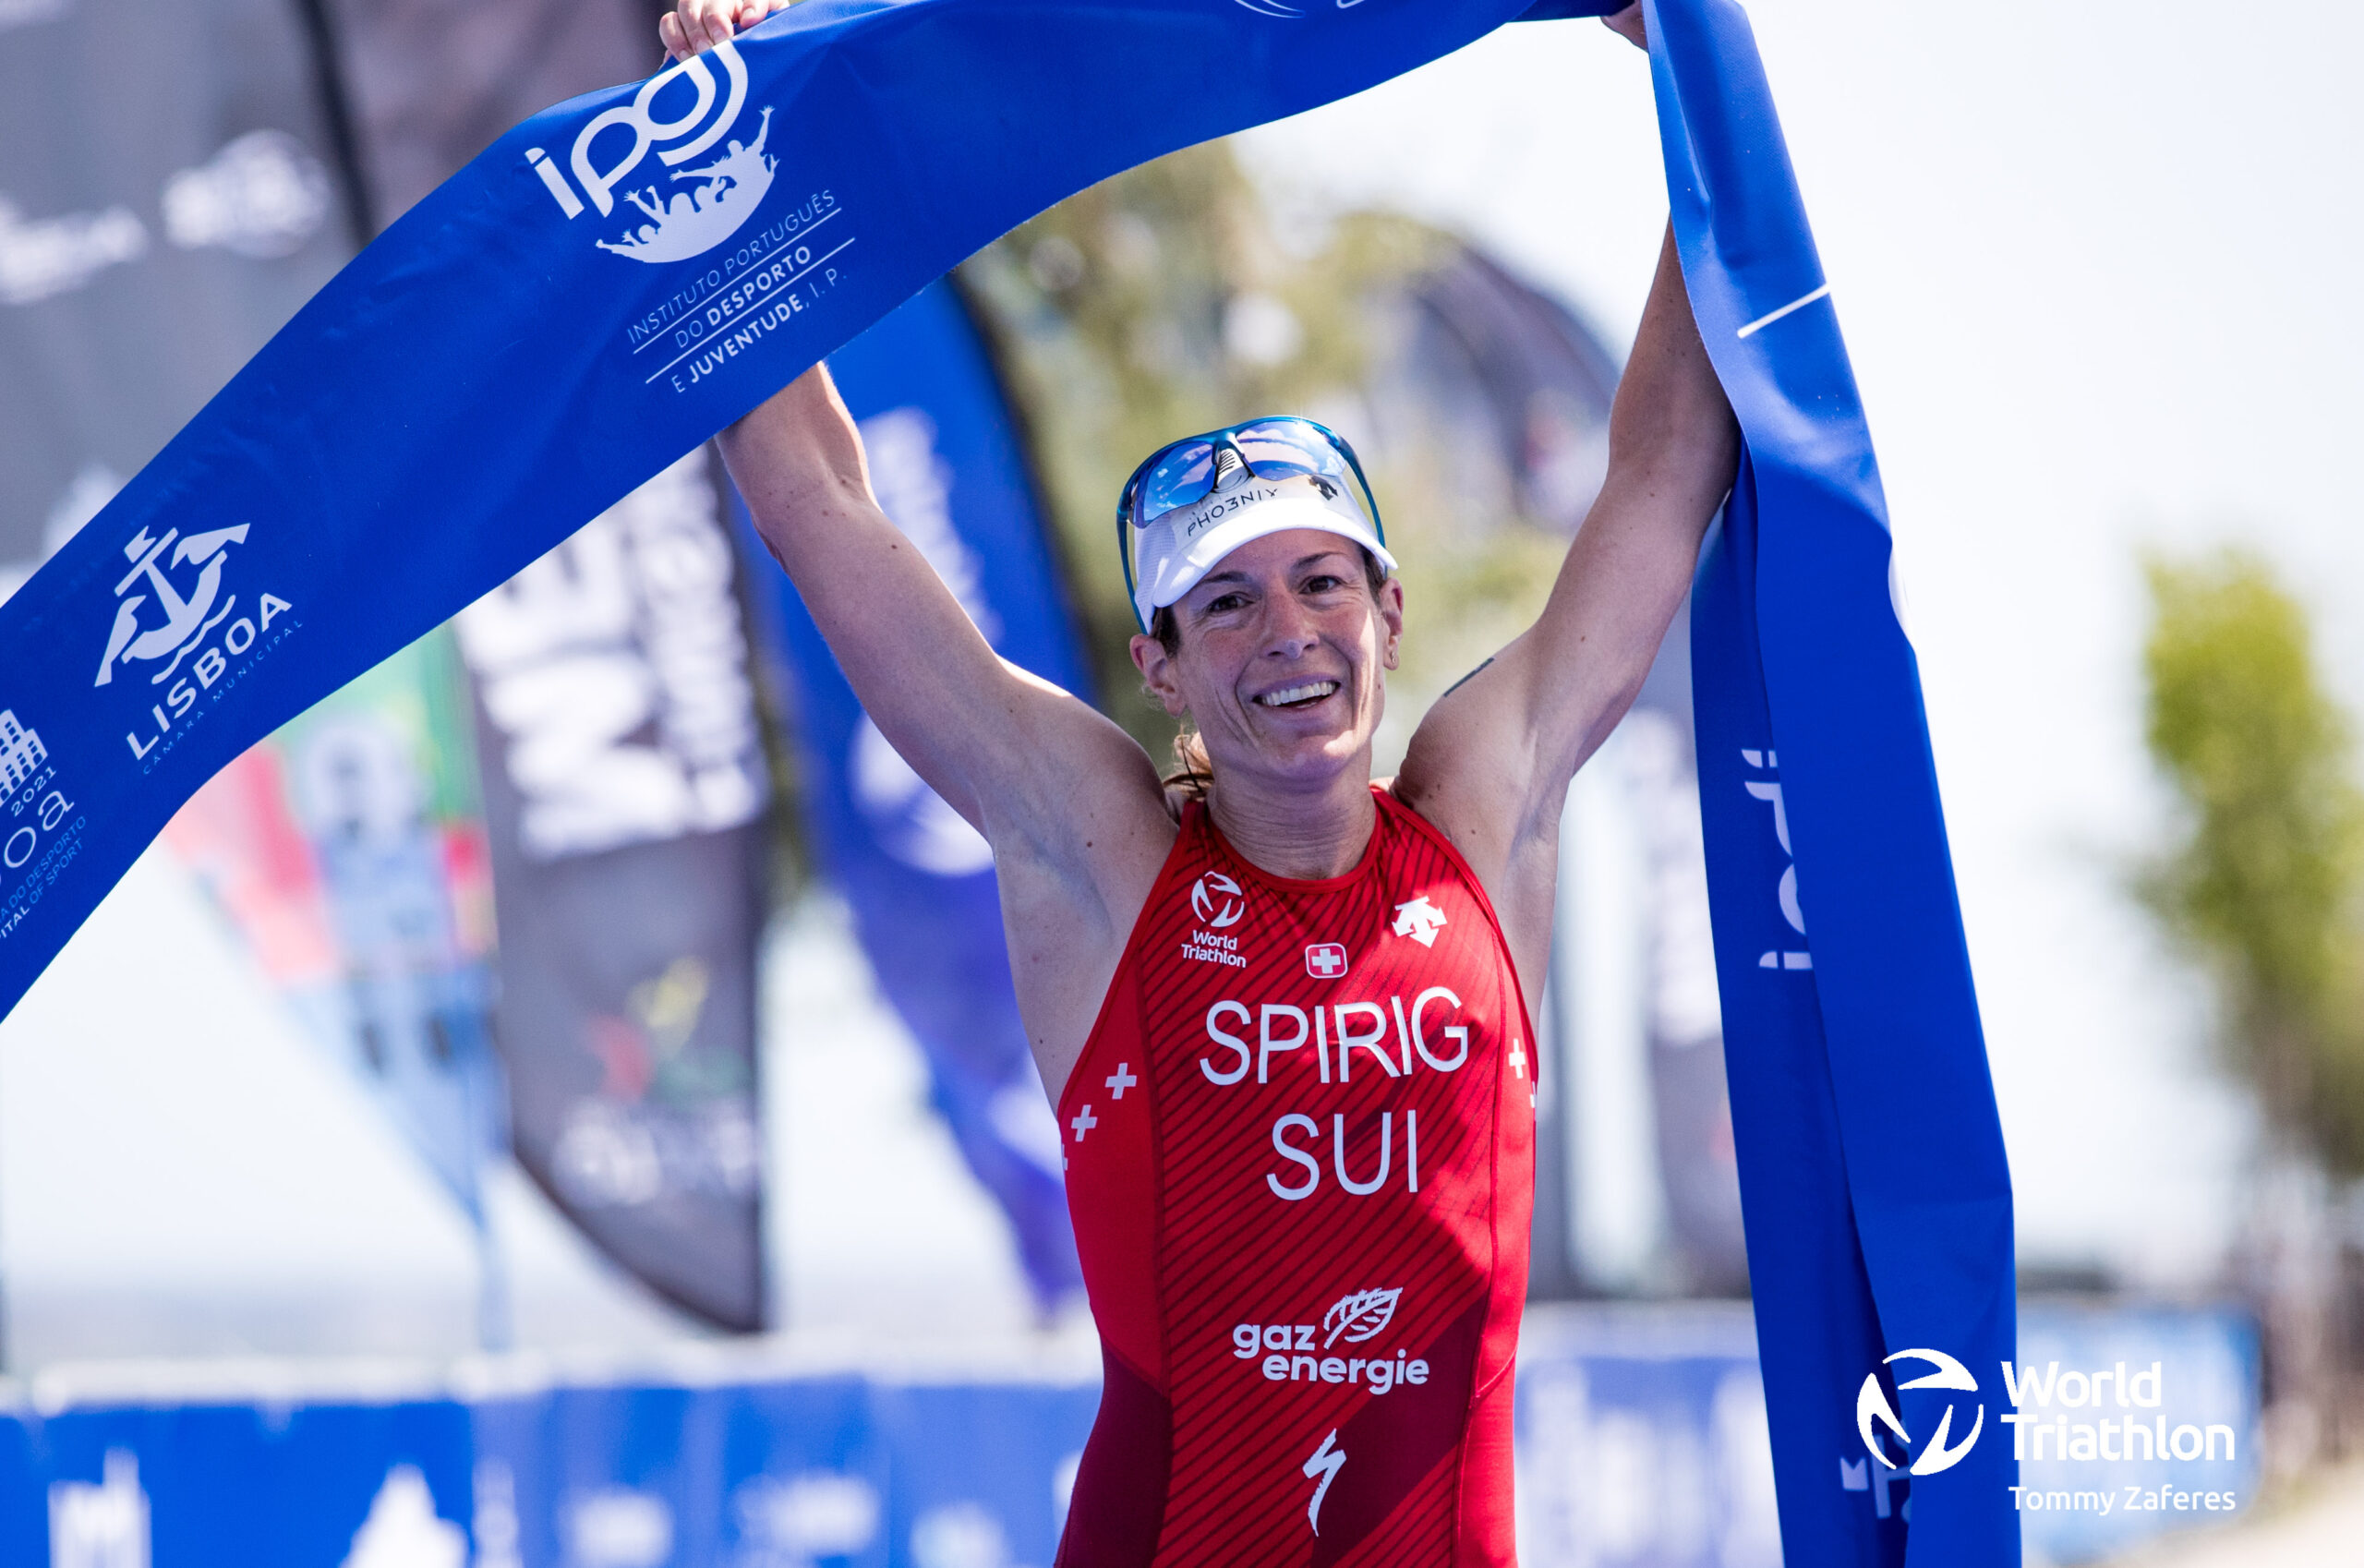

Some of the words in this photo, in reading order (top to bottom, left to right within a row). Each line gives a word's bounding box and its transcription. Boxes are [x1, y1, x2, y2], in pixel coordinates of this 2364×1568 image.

[627, 270, 720, 344] INSTITUTO
[724, 189, 836, 275] PORTUGUÊS
[675, 320, 705, 348] DO
[707, 246, 812, 326] DESPORTO
[671, 375, 686, 393] E
[688, 294, 810, 383] JUVENTUDE,
[127, 592, 293, 760] LISBOA
[212, 620, 303, 702] MUNICIPAL
[11, 766, 56, 817] 2021
[0, 906, 30, 938] ITAL
[29, 882, 43, 904] OF
[45, 838, 82, 885] SPORT
[8, 885, 26, 908] DO
[26, 816, 86, 887] DESPORTO
[1181, 943, 1247, 969] Triathlon
[1192, 930, 1238, 951] World
[1200, 986, 1468, 1086] SPIRIG
[1266, 1109, 1418, 1200] SUI
[1233, 1323, 1316, 1358] gaz
[1262, 1348, 1429, 1395] energie
